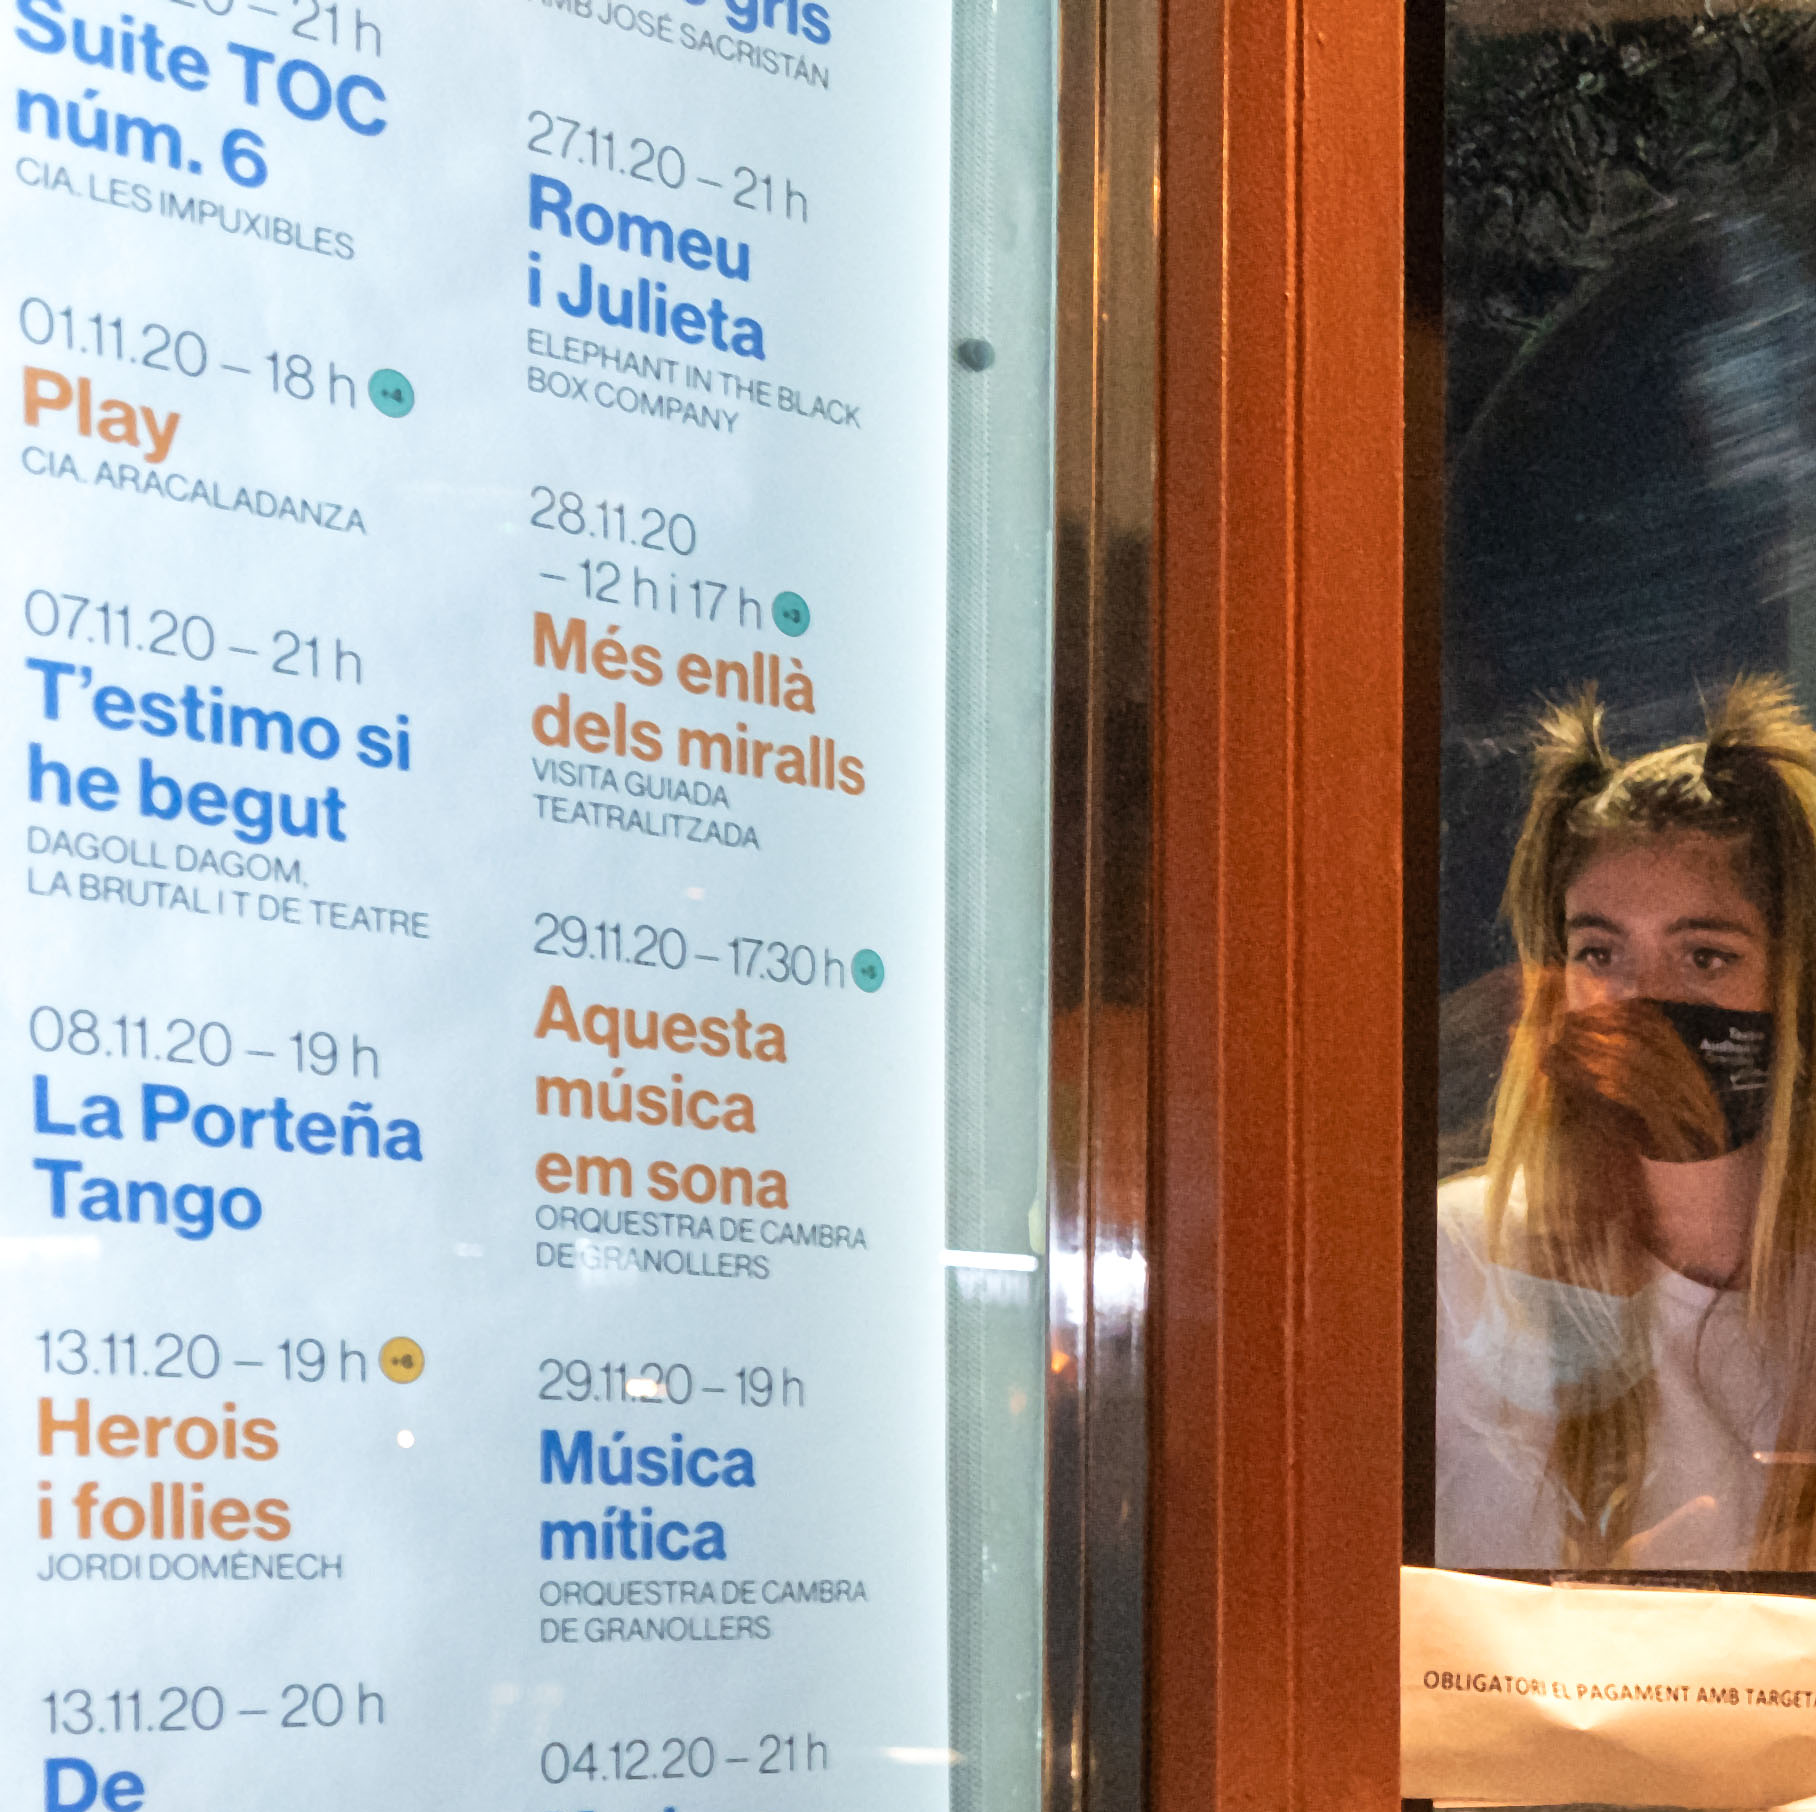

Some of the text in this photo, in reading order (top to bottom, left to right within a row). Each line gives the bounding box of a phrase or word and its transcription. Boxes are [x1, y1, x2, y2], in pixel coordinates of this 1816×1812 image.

[597, 0, 674, 44] JOSÉ
[13, 0, 388, 137] Suite TOC
[15, 87, 268, 189] núm. 6
[527, 110, 772, 214] 27.11.20 21
[16, 156, 355, 260] CIA. LES IMPUXIBLES
[528, 172, 752, 283] Romeu
[556, 262, 767, 362] Julieta
[19, 296, 315, 400] 01.11.20 18
[527, 328, 861, 429] ELEPHANT IN THE BLACK
[23, 366, 181, 464] Play
[528, 365, 739, 434] BOX COMPANY
[20, 445, 367, 536] CIA. ARACALADANZA
[530, 485, 697, 556] 28.11.20
[578, 558, 728, 622] 12 17
[24, 589, 319, 678] 07.11.20 21
[534, 611, 815, 715] Més enllà
[356, 712, 411, 772] si
[532, 692, 865, 796] dels miralls
[27, 741, 348, 846] he begut
[531, 756, 731, 810] VISITA GUIADA
[27, 825, 168, 870] DAGOLL
[532, 793, 762, 851] TEATRALITZADA
[28, 867, 430, 939] LA BRUTAL DE TEATRE
[533, 912, 817, 986] 29.11.20 17.30
[29, 1005, 340, 1076] 08.11.20 19
[534, 985, 787, 1064] Aquesta
[32, 1073, 424, 1162] La Porteña
[536, 1067, 756, 1134] música
[31, 1156, 263, 1242] Tango
[536, 1152, 789, 1210] em sona
[535, 1204, 868, 1250] ORQUESTRA DE CAMBRA
[536, 1241, 576, 1269] DE
[35, 1328, 328, 1383] 13.11.20 19
[735, 1366, 776, 1407] 19
[38, 1397, 279, 1461] Herois
[540, 1428, 758, 1488] Música
[72, 1481, 291, 1541] follies
[540, 1505, 728, 1562] mítica
[37, 1553, 143, 1581] JORDI
[539, 1579, 869, 1606] ORQUESTRA DE CAMBRA
[541, 1615, 774, 1643] DE GRANOLLERS
[41, 1683, 345, 1735] 13.11.20 20
[1423, 1669, 1545, 1697] OBLIGATORI
[1552, 1681, 1570, 1701] EL
[1577, 1683, 1690, 1703] PAGAMENT
[1697, 1686, 1740, 1706] AMB
[541, 1733, 796, 1784] 04.12.20 21
